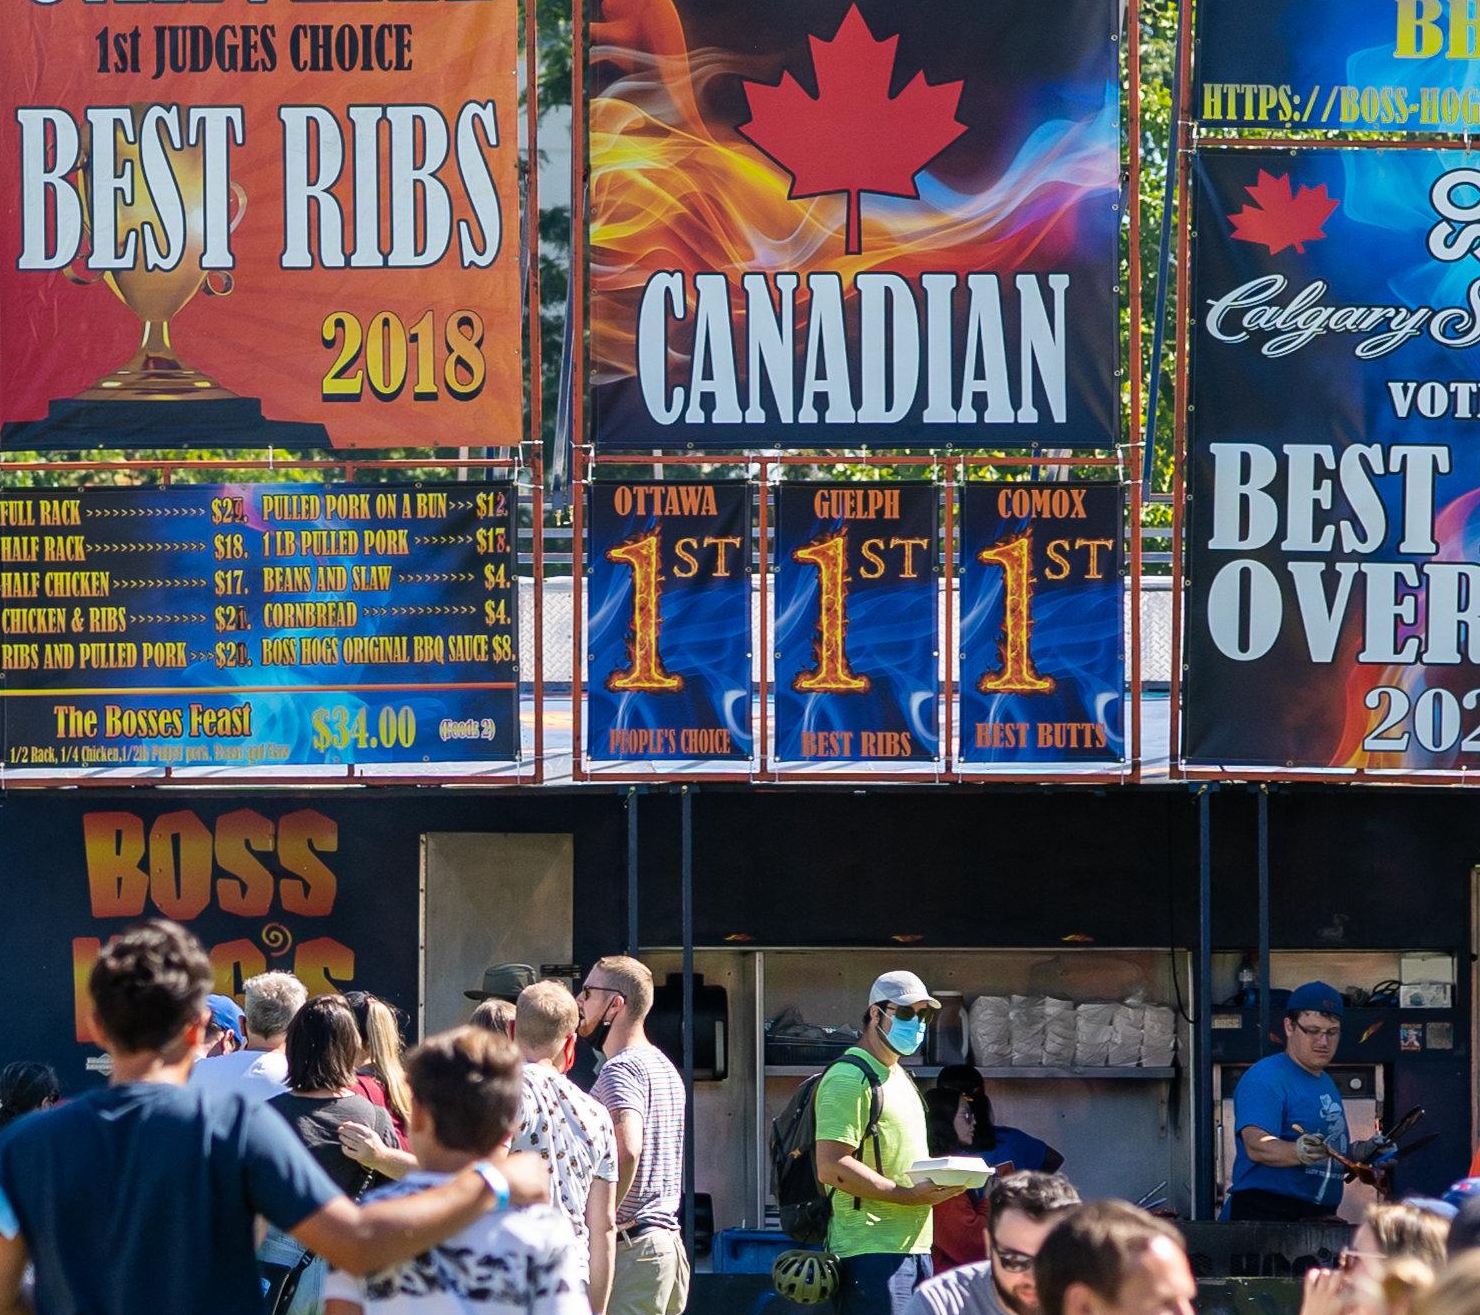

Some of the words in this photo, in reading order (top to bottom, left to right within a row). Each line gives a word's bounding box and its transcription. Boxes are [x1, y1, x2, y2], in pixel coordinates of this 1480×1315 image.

[96, 27, 141, 74] 1st
[152, 25, 277, 80] JUDGES
[289, 23, 413, 74] CHOICE
[17, 105, 245, 272] BEST
[279, 100, 501, 270] RIBS
[637, 270, 1071, 426] CANADIAN
[1205, 273, 1430, 359] Calgary
[320, 308, 485, 402] 2018
[1208, 442, 1449, 555] BEST
[0, 572, 40, 598] HALF
[44, 571, 110, 597] CHICKEN
[263, 566, 311, 592] BEANS
[316, 567, 349, 591] AND
[352, 565, 391, 591] SLAW
[263, 602, 357, 628] CORNBREAD
[54, 705, 97, 739] The
[104, 704, 184, 738] Bosses
[188, 703, 252, 737] Feast
[312, 706, 416, 749] $34.00
[83, 809, 338, 919] BOSS
